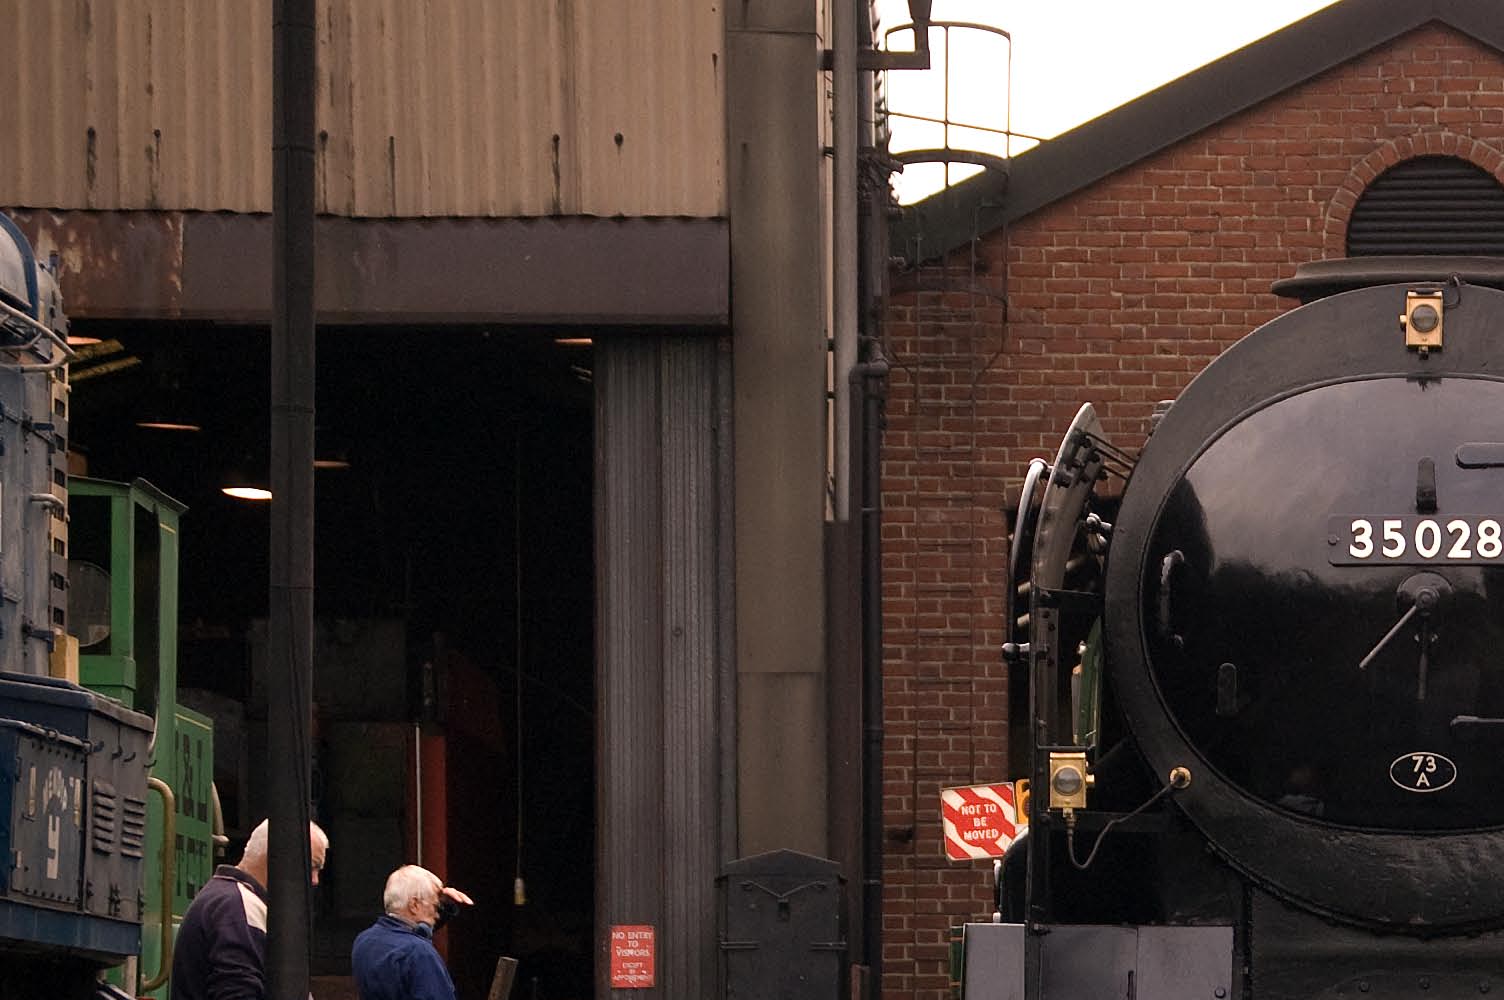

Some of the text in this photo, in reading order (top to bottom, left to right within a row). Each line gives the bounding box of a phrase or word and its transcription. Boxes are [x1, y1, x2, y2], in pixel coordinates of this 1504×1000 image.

[1349, 519, 1503, 559] 35028
[1412, 755, 1437, 773] 73
[1415, 771, 1431, 787] A
[961, 803, 998, 816] NOT TO
[973, 816, 988, 827] BE
[963, 828, 999, 841] MOVED
[612, 931, 625, 940] NO
[627, 939, 640, 948] TO
